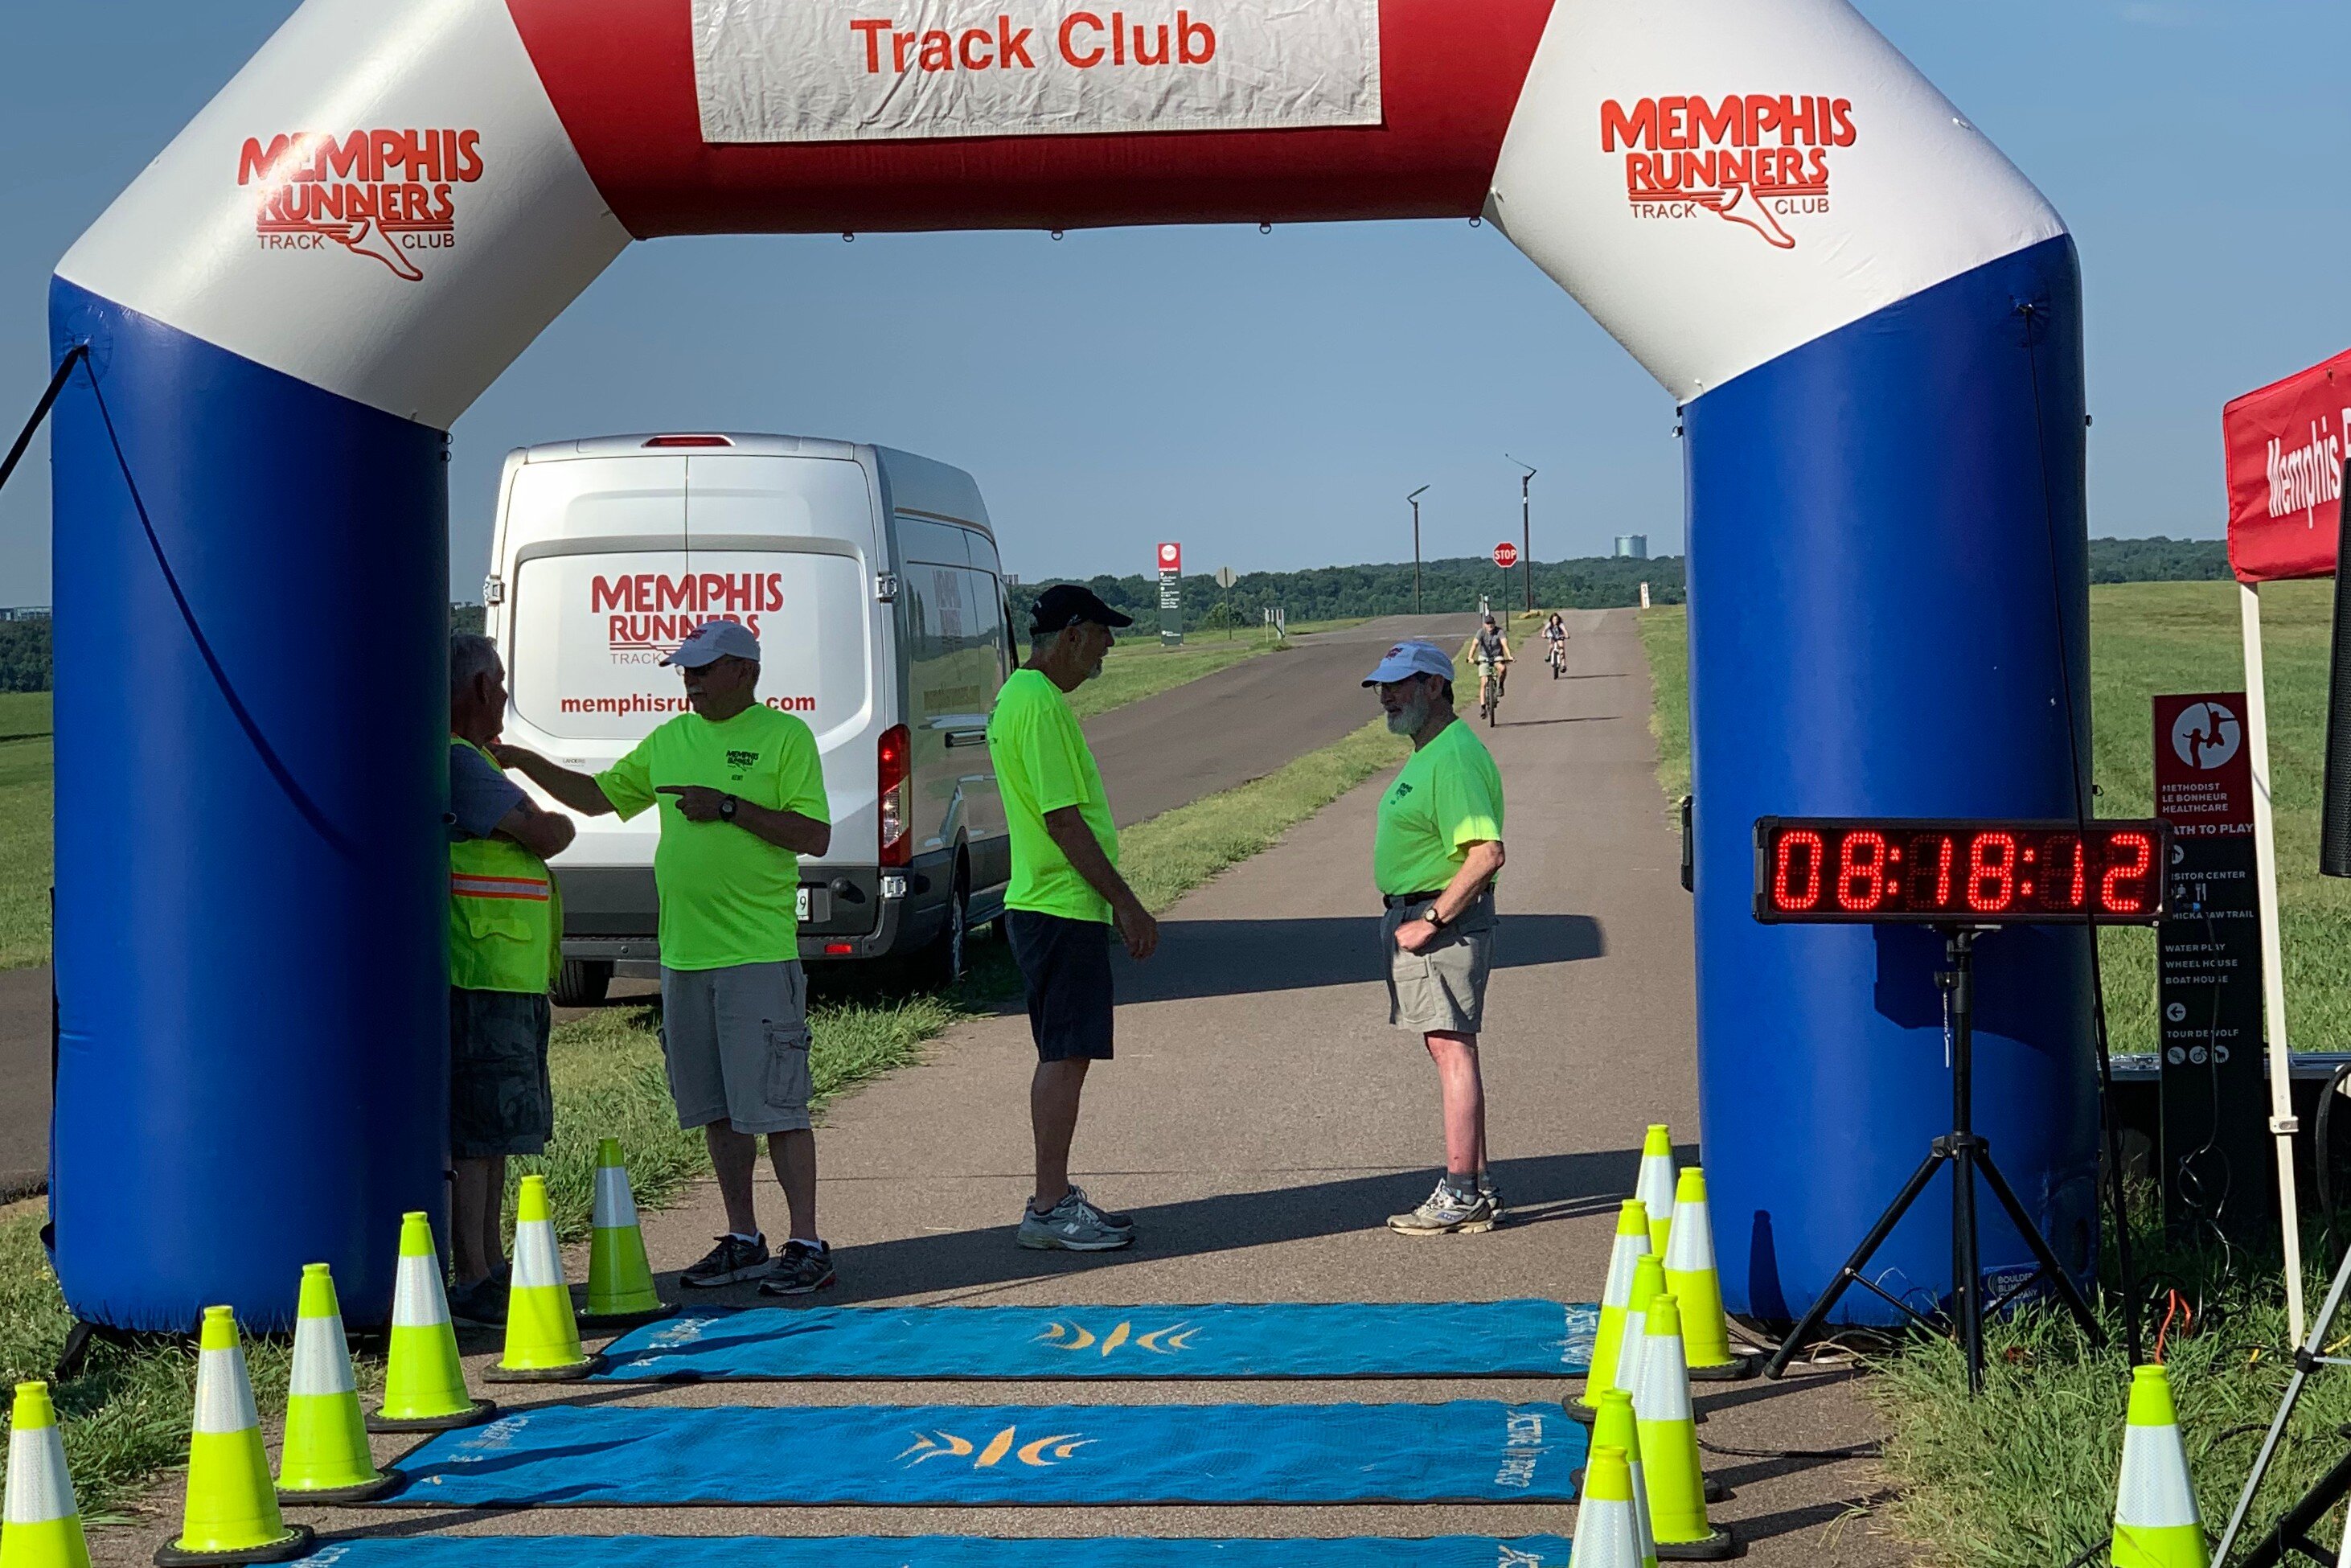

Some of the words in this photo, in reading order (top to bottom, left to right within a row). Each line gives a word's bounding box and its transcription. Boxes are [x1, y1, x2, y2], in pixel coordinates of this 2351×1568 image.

[851, 14, 1035, 74] Track
[1058, 10, 1217, 68] Club
[1600, 95, 1857, 152] MEMPHIS
[238, 129, 483, 185] MEMPHIS
[1626, 147, 1829, 190] RUNNERS
[256, 183, 455, 220] RUNNERS
[1630, 203, 1697, 219] TRACK
[1775, 198, 1830, 214] CLUB
[257, 234, 325, 250] TRACK
[402, 234, 455, 249] CLUB
[2267, 416, 2341, 529] Memphis
[1495, 549, 1516, 560] STOP
[592, 573, 784, 613] MEMPHIS
[609, 614, 761, 641] RUNNS
[610, 653, 662, 664] TRACK
[2162, 783, 2220, 792] METHODIST
[2177, 793, 2227, 802] BONHEUR
[2162, 803, 2229, 813] HEALTHCARE
[2199, 824, 2216, 834] TO
[2220, 823, 2255, 834] PLAY
[1775, 831, 2148, 911] 08:18:12
[2172, 872, 2204, 880] ISITOR
[2206, 871, 2246, 880] CENTER
[2226, 910, 2254, 918] TRAIL
[2165, 944, 2199, 952] WATER
[2165, 960, 2201, 968] WHEEL
[2165, 976, 2191, 984] BOAT
[2166, 1030, 2193, 1038] TOUR
